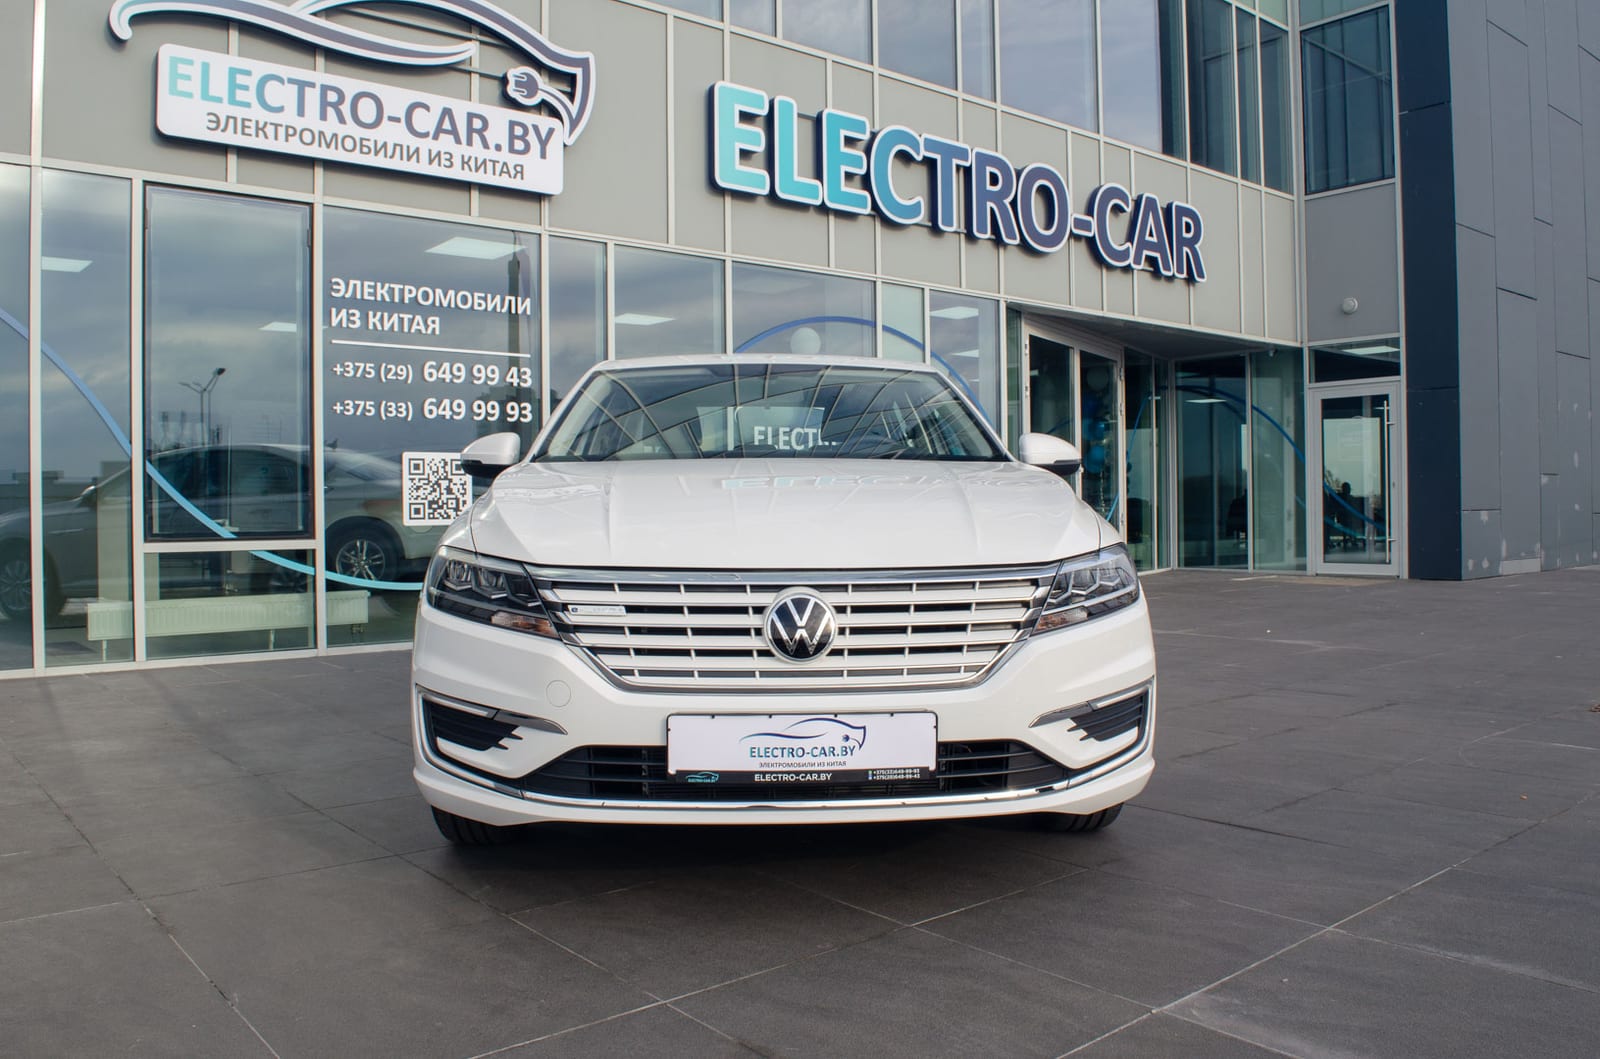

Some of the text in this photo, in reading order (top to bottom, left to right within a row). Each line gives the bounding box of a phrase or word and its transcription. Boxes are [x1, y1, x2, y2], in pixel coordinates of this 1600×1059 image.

[168, 55, 556, 160] ELECTRO-CAR.BY
[206, 112, 525, 181] ЭЛЕКТРОМОБИЛИ ИЗ КИТАЯ
[711, 81, 1206, 281] ELECTRO-CAR
[330, 278, 532, 315] ЭЛЕКТРОМОБИЛИ
[330, 308, 441, 335] ИЗ КИТАЯ
[333, 361, 533, 388] +375 (29) 649 99 43
[333, 398, 533, 423] +375 (33) 649 99 93
[749, 746, 856, 758] ELECTRO-CAR.BY
[754, 773, 833, 782] ELECTRO-CAR.BY
